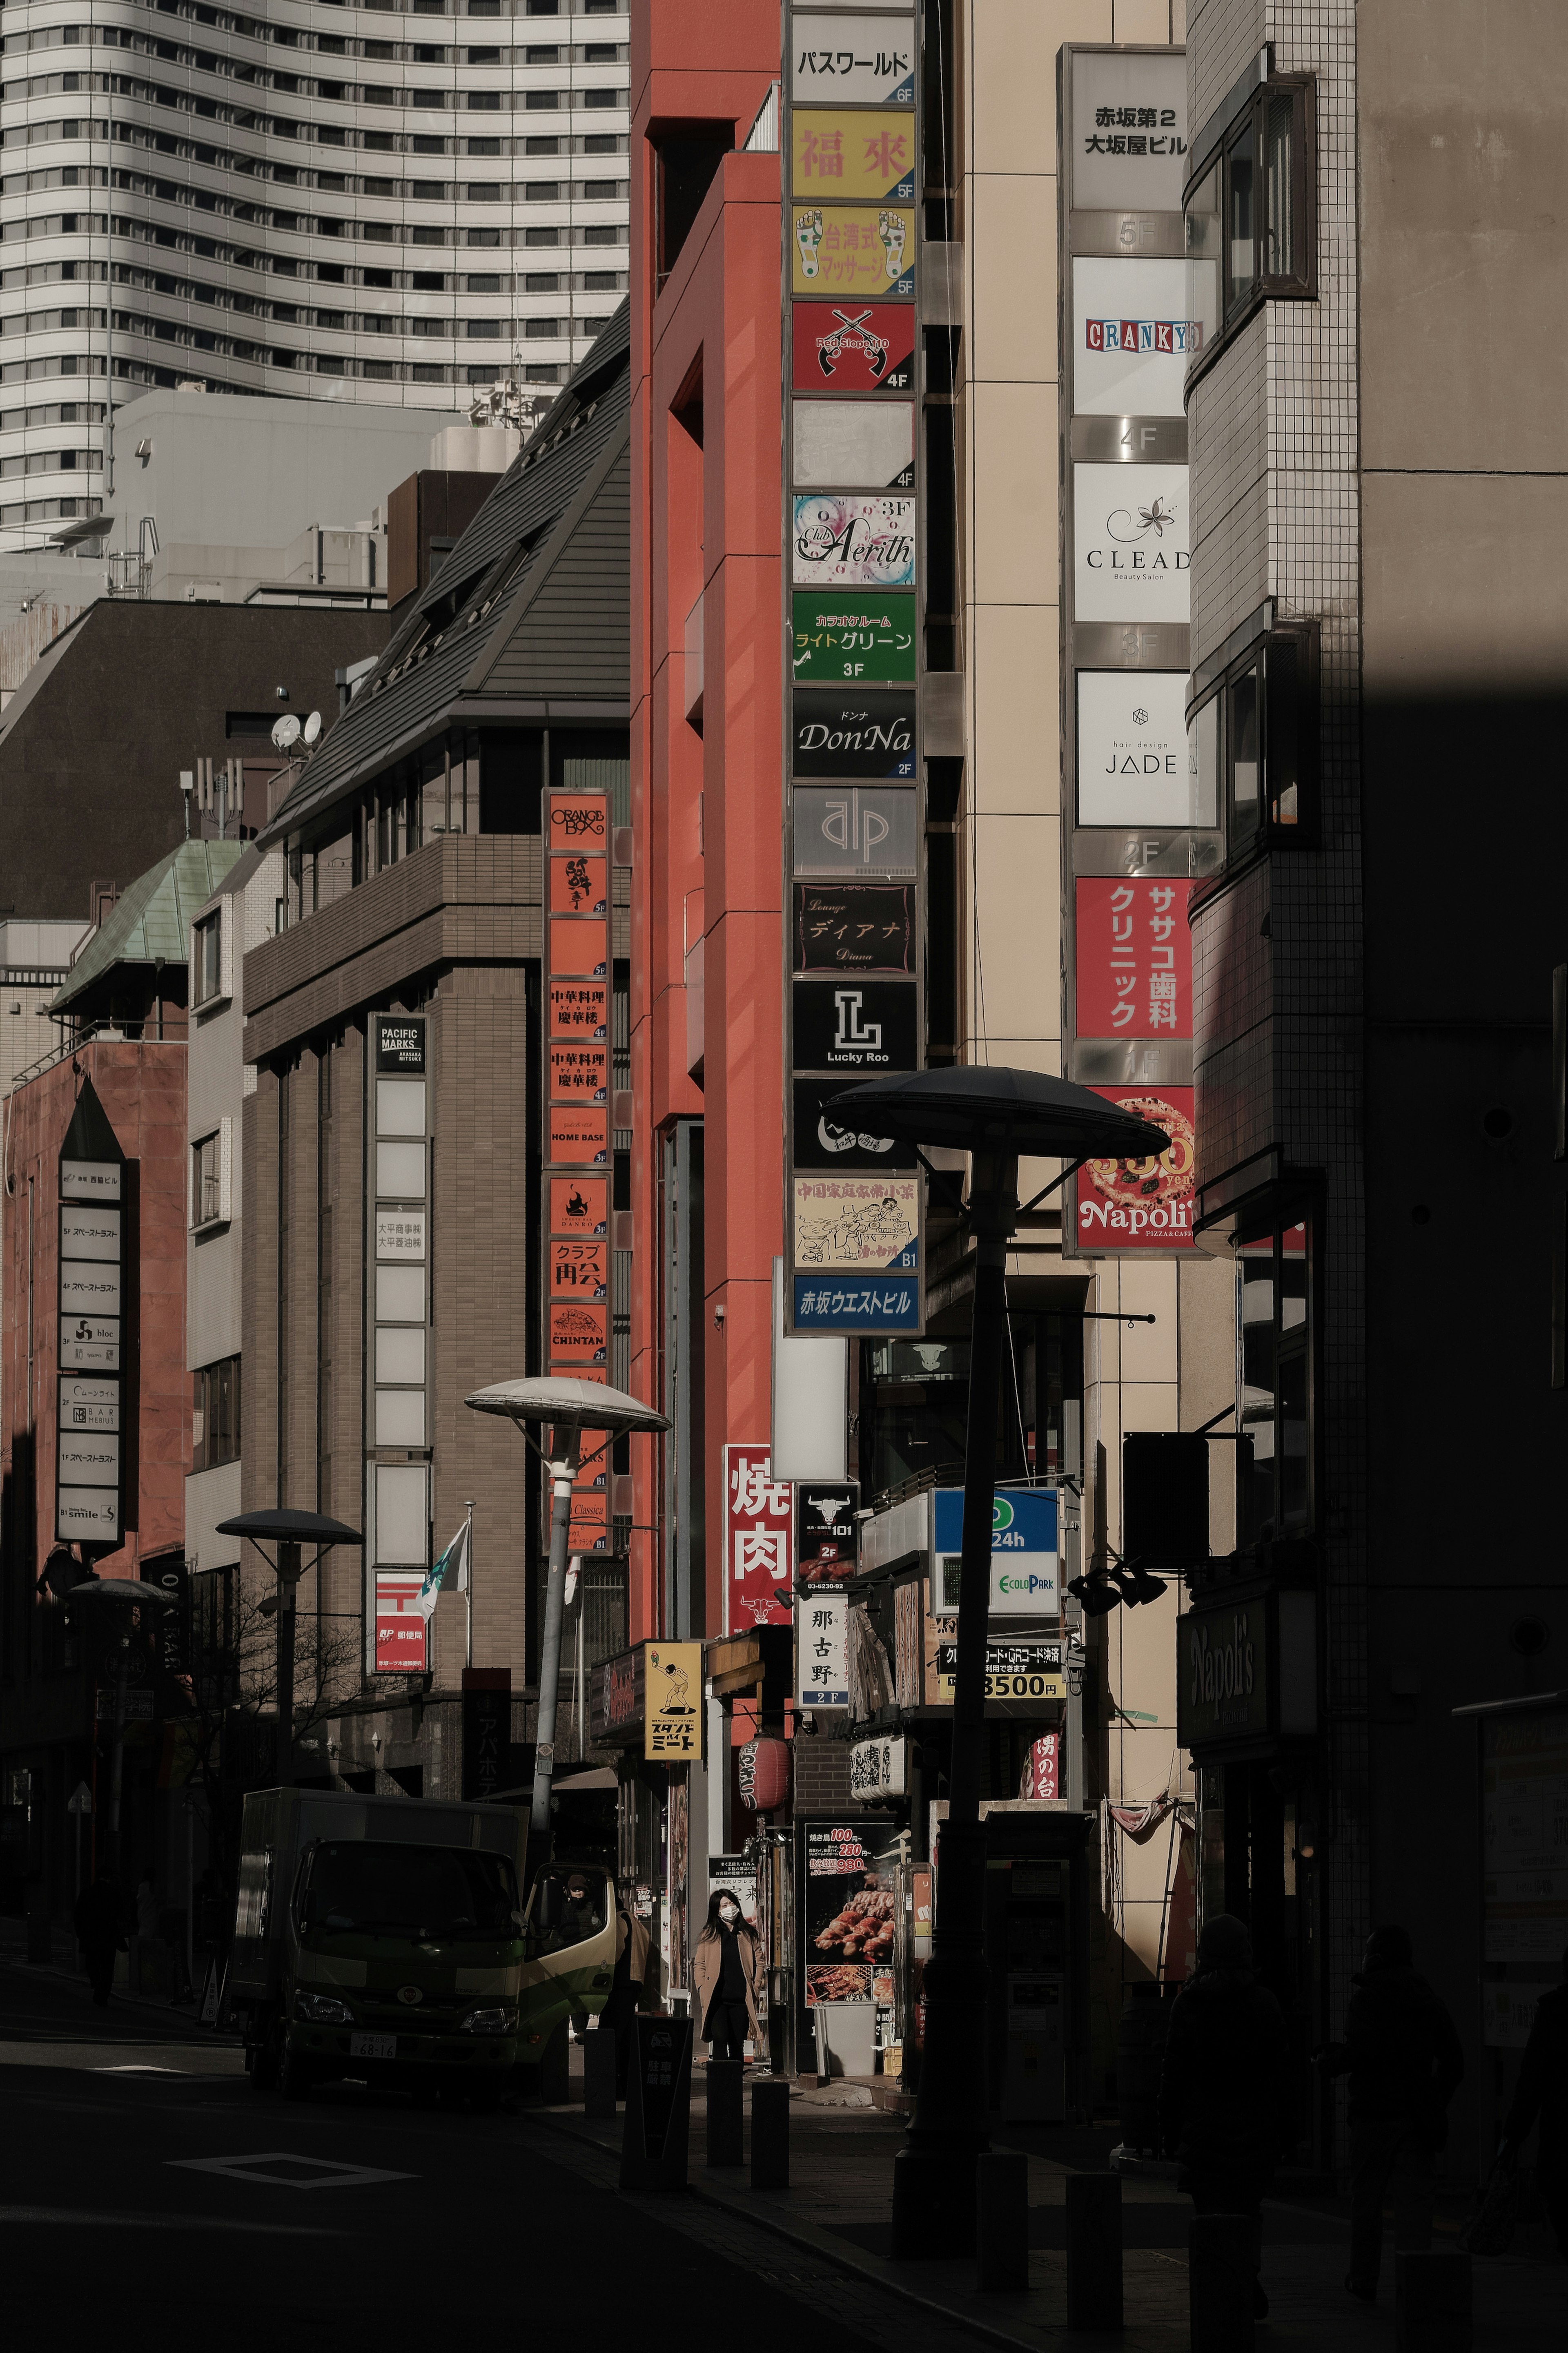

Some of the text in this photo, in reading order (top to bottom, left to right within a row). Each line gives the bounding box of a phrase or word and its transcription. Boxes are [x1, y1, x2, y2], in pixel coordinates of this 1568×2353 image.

[798, 52, 908, 77] パスワールド
[897, 89, 912, 102] 6F
[1095, 107, 1176, 127] 赤坂第2
[1085, 136, 1187, 155] 大坂屋ビル
[898, 184, 913, 198] 5F
[825, 223, 878, 251] 台湾式
[1120, 221, 1156, 245] 5F
[820, 256, 884, 283] マッサージ
[898, 281, 913, 293] 5F
[816, 338, 889, 349] Red Slope 110
[887, 375, 908, 387] 4F
[1121, 426, 1157, 451] 4F
[897, 473, 913, 486] 4F
[882, 501, 910, 516] 3F
[794, 517, 914, 568] Club Aerith
[1087, 550, 1190, 570] CLEAD
[1114, 573, 1141, 581] Beauty
[816, 616, 891, 627] カラオケルーム
[1122, 633, 1158, 658] 3F
[843, 663, 864, 676] 3F
[841, 711, 869, 721] ドンナ
[799, 718, 911, 751] DonNa
[1137, 741, 1168, 750] design
[898, 764, 912, 774] 2F
[1105, 755, 1176, 774] JADE
[551, 809, 604, 825] ORANGE
[565, 819, 604, 835] BOX
[1124, 841, 1160, 865] 2F
[595, 904, 605, 912] 5F
[807, 899, 848, 914] Lounge
[810, 919, 900, 940] ディアナ
[835, 948, 874, 960] Diana
[1109, 886, 1136, 1028] クリニック
[1148, 885, 1177, 1030] ササコ歯科
[595, 966, 605, 975] 5F
[551, 990, 604, 1004] 中華料理
[558, 1011, 598, 1025] 慶華楼
[835, 991, 882, 1049] L
[382, 1029, 418, 1039] PACIFIC
[595, 1029, 606, 1037] 4F
[382, 1039, 414, 1048] MARKS
[551, 1053, 604, 1066] 中華料理
[827, 1052, 889, 1064] Lucky Roo
[1125, 1049, 1160, 1074] 1F
[558, 1074, 598, 1088] 慶華楼
[595, 1091, 606, 1100] 4F
[834, 1134, 856, 1151] 和牛
[858, 1134, 881, 1151] 酒場
[596, 1154, 606, 1162] 3F
[90, 1176, 118, 1185] 西脇ビル
[1166, 1175, 1190, 1187] yen
[557, 1245, 600, 1260] クラブ
[902, 1253, 916, 1267] B1
[555, 1262, 601, 1286] 再会
[595, 1287, 606, 1297] 2F
[800, 1291, 911, 1315] 赤坂ウエストビル
[97, 1329, 114, 1338] bloc
[552, 1336, 604, 1345] CHINTAN
[595, 1351, 606, 1359] 2F
[596, 1477, 605, 1485] B1
[69, 1511, 98, 1519] smile
[575, 1504, 604, 1515] Classica
[832, 1526, 851, 1536] 101
[596, 1540, 605, 1548] B1
[991, 1532, 1025, 1547] 24h
[821, 1547, 836, 1557] 2F
[397, 1631, 423, 1639] 郵便局
[811, 1610, 833, 1686] 那古野
[652, 1724, 694, 1733] スタンド
[652, 1736, 694, 1751] ミート
[361, 2044, 393, 2056] 68-16
